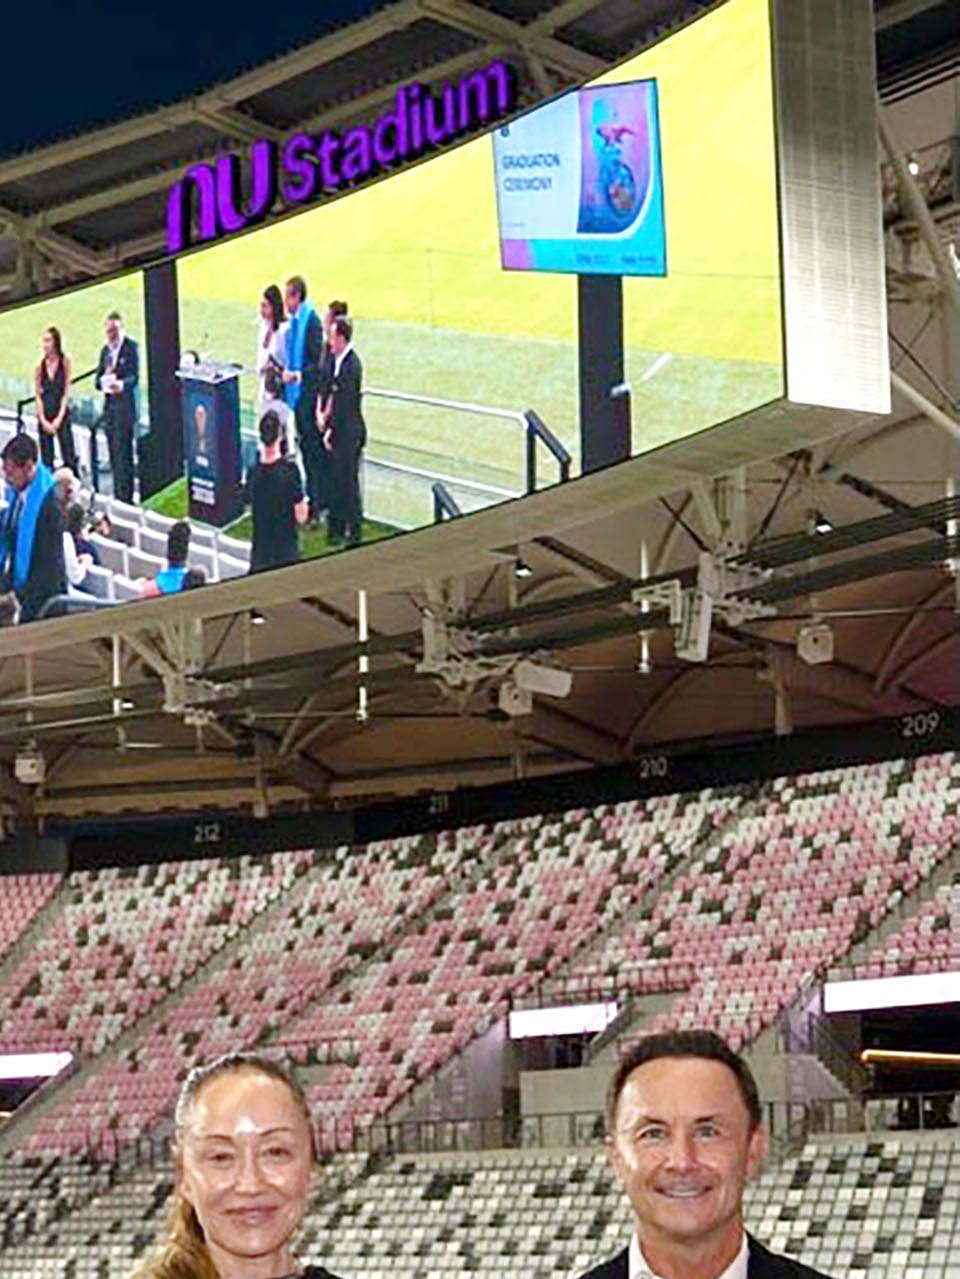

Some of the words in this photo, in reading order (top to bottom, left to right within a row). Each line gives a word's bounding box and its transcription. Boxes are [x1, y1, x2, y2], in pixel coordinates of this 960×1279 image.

[502, 153, 560, 170] GRADUATION
[902, 711, 940, 736] 209
[640, 756, 668, 778] 210
[194, 823, 221, 842] 212
